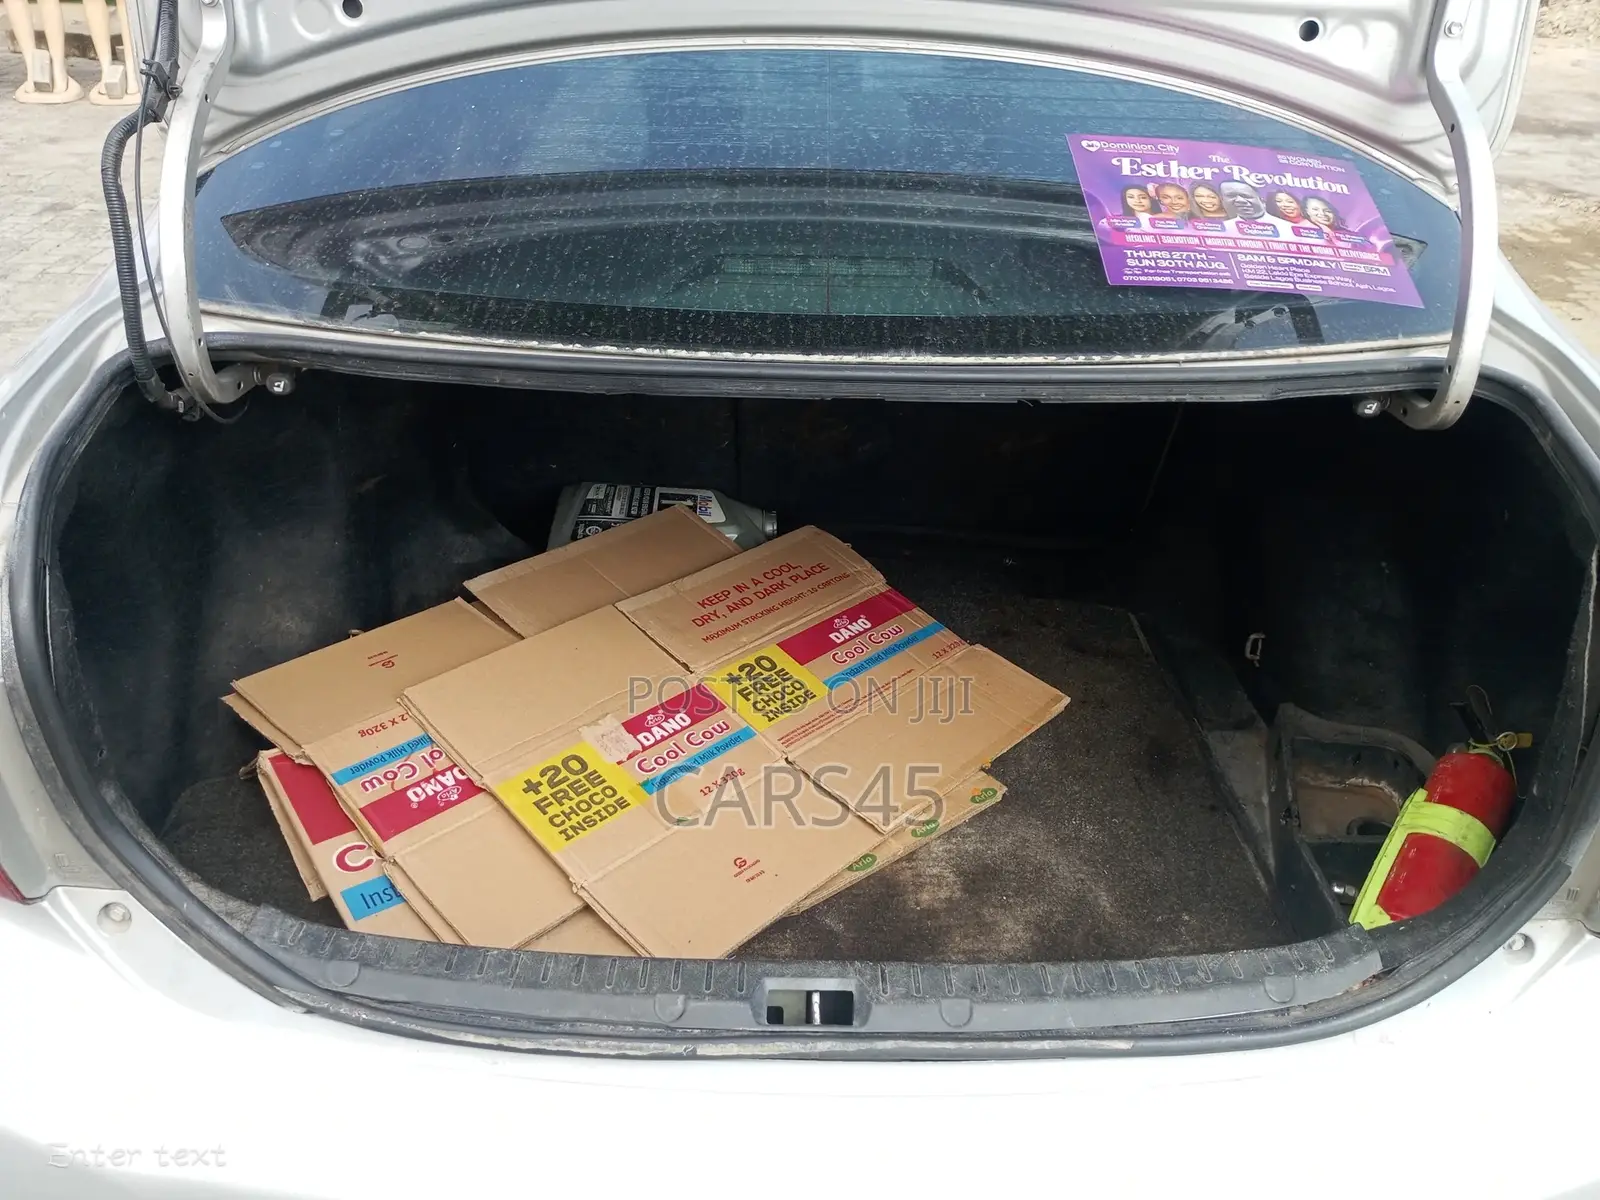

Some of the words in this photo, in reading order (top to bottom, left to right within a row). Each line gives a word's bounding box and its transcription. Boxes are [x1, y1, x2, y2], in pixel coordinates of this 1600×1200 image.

[1100, 141, 1156, 150] Dominion
[1157, 144, 1180, 153] City
[1208, 154, 1231, 164] The
[1111, 157, 1220, 180] Esther
[1223, 164, 1350, 195] Revolution
[1123, 250, 1170, 259] THURS
[1171, 251, 1206, 260] 27TH
[1126, 259, 1155, 267] SUN
[1157, 259, 1194, 268] 30TH
[1195, 261, 1229, 270] AUG.
[1236, 253, 1265, 264] 8AM
[1278, 256, 1303, 267] 5PM
[1302, 258, 1338, 270] DAILY
[697, 494, 713, 517] Mobil
[692, 609, 727, 628] DRY,
[725, 596, 754, 614] AND
[753, 580, 792, 600] DARK
[788, 562, 831, 584] PLACE
[697, 589, 731, 609] KEEP
[732, 582, 750, 594] IN
[751, 577, 764, 587] A
[763, 562, 803, 581] COOL,
[701, 621, 744, 644] MAXIMUM
[740, 604, 780, 625] STACKING
[778, 591, 808, 609] HEIGHT:
[829, 617, 872, 644] DANO
[831, 640, 872, 665] Cool
[866, 624, 904, 646] Cow
[895, 635, 921, 651] Powder
[932, 652, 942, 660] 12
[726, 654, 778, 686] +20
[737, 667, 794, 702] FREE
[752, 680, 805, 712] CHOCO
[762, 689, 817, 722] INSIDE
[358, 722, 388, 738] 320g
[388, 717, 400, 727] X
[636, 712, 692, 747] DANO
[388, 747, 408, 760] Milk
[635, 740, 687, 774] Cool
[684, 719, 732, 748] Cow
[698, 750, 716, 765] Milk
[714, 734, 743, 756] Powder
[349, 756, 388, 775] Powder
[360, 760, 419, 794] Cow
[522, 754, 589, 796] +20
[532, 768, 608, 816] FREE
[700, 786, 712, 797] 12
[712, 780, 722, 790] X
[720, 768, 746, 784] 320g
[975, 789, 994, 802] Arla
[548, 785, 618, 828] CHOCO
[558, 796, 632, 842] INSIDE
[852, 856, 872, 870] Arla
